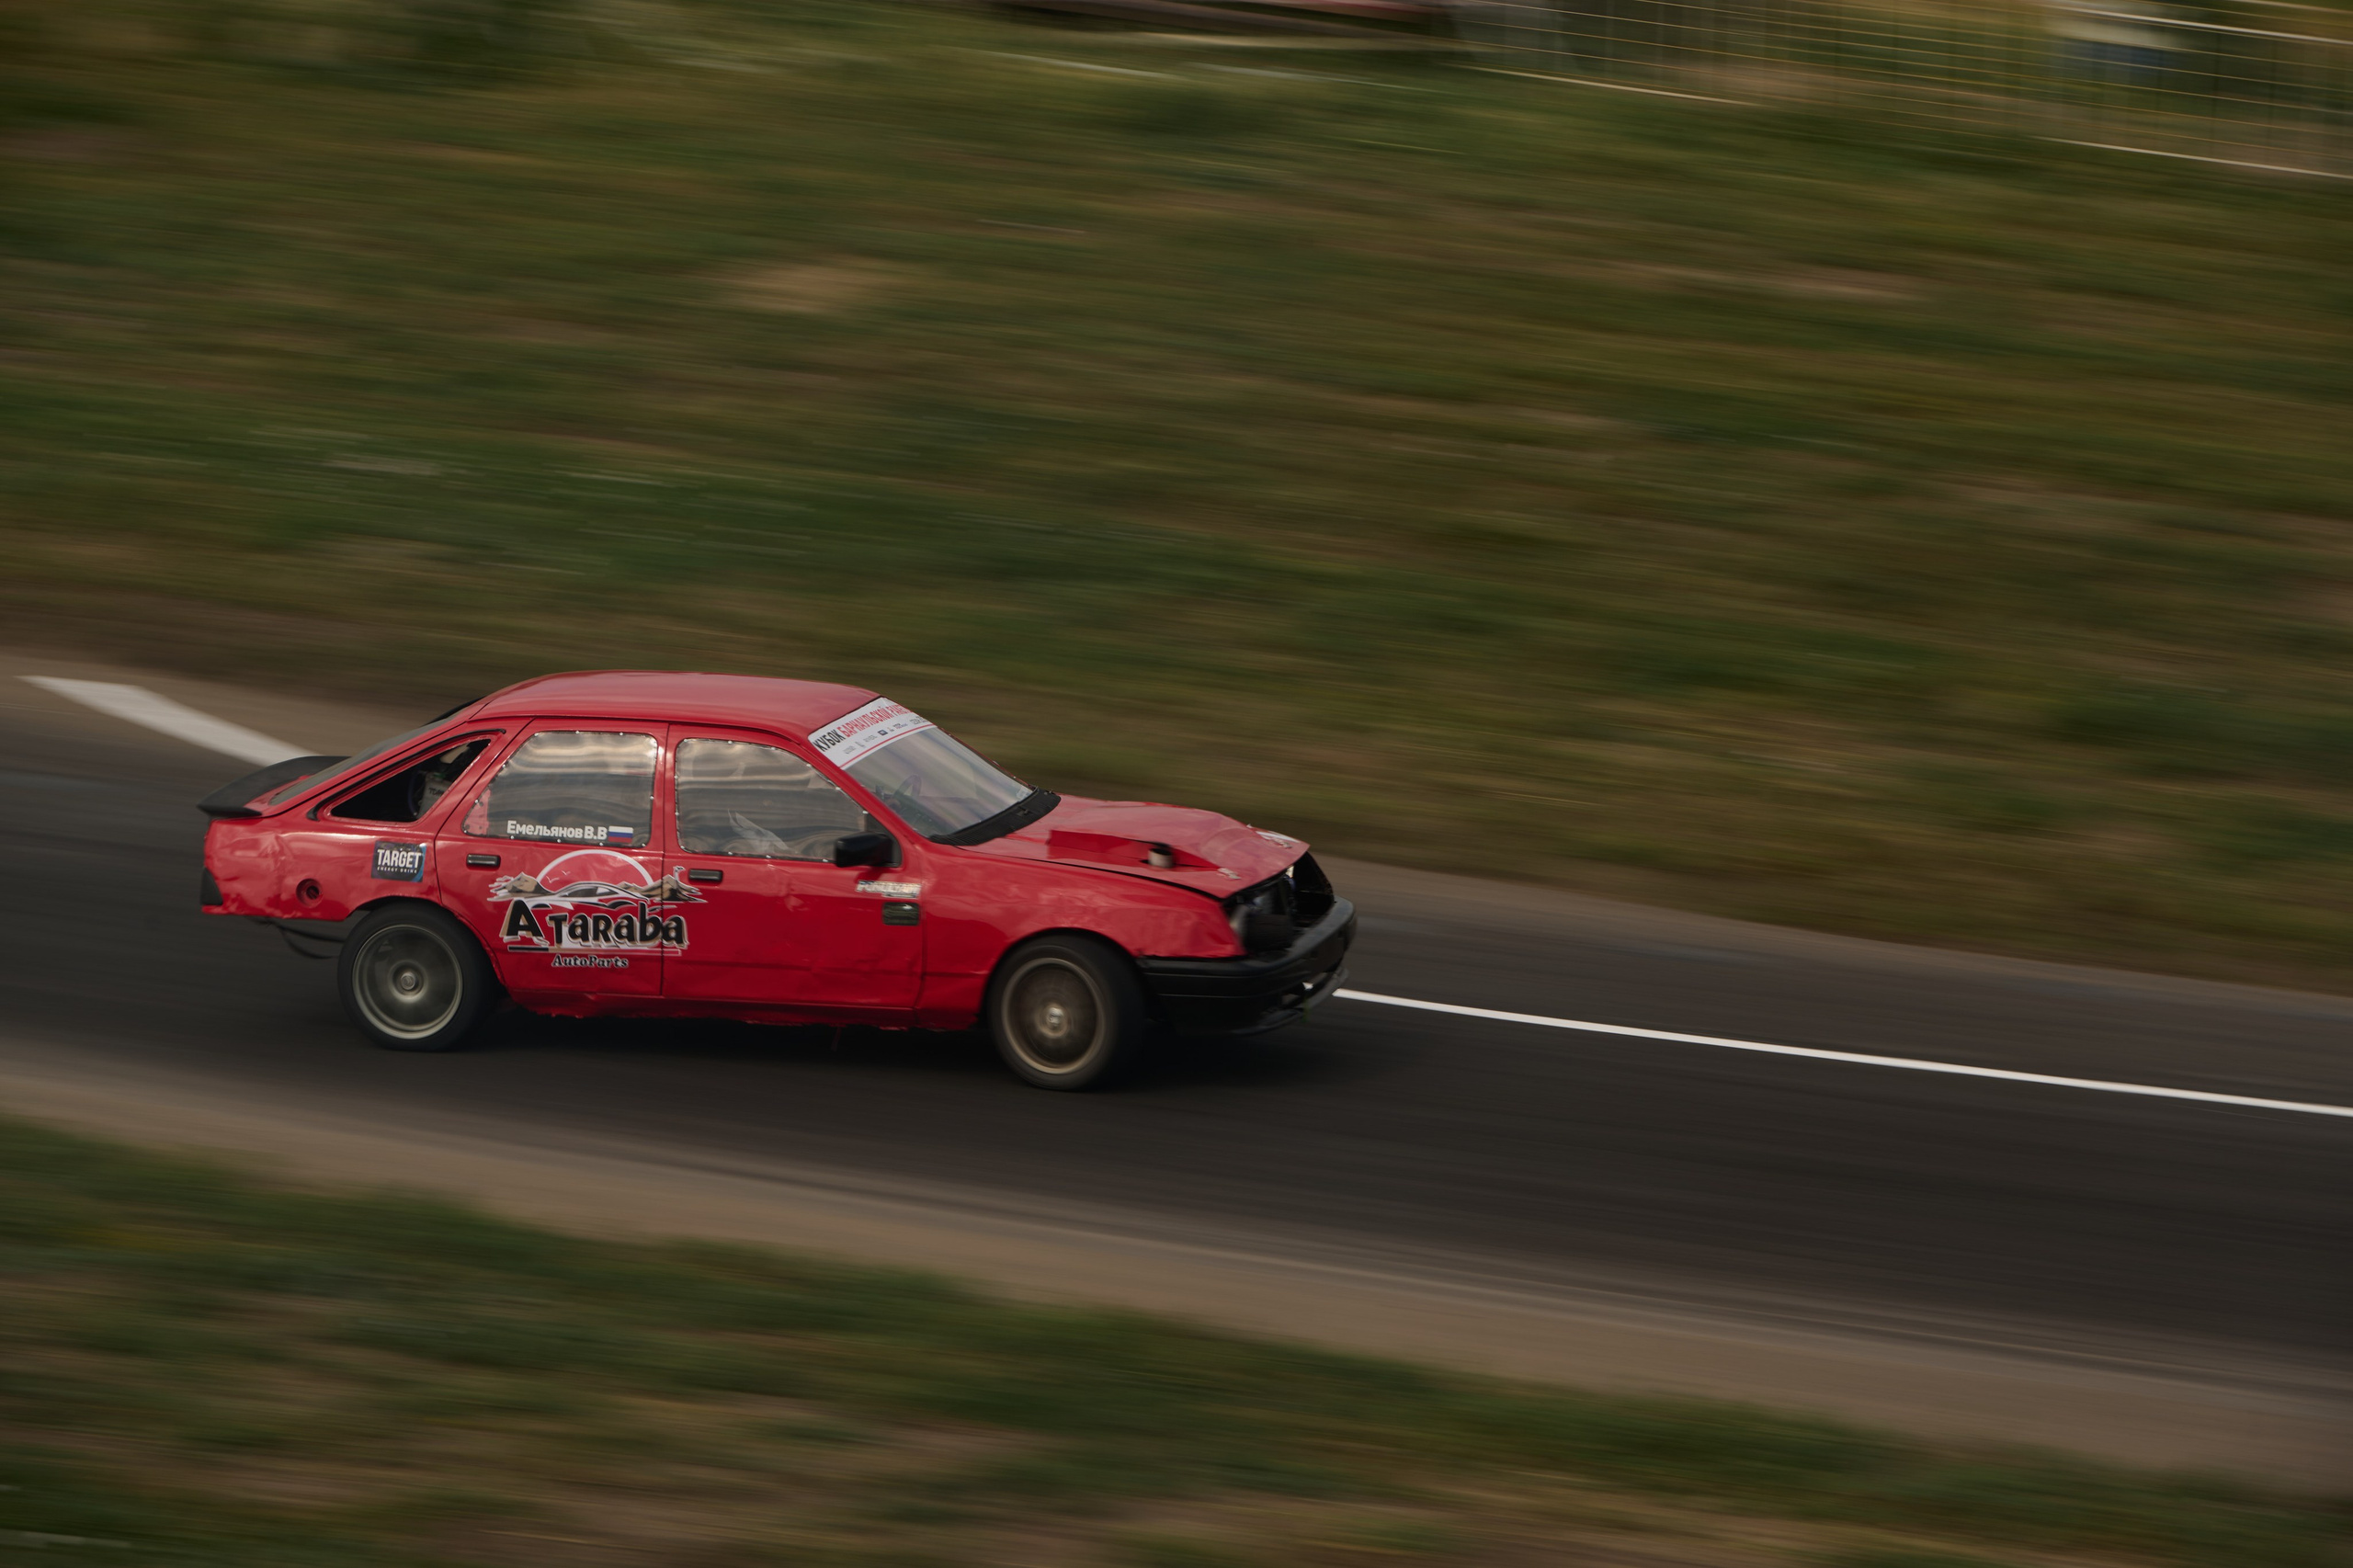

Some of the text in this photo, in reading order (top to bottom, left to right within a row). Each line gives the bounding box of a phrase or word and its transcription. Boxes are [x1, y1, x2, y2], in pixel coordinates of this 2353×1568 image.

[813, 729, 846, 752] КУБОК
[836, 706, 893, 737] БАРНАУЛЬСКОЙ
[506, 820, 607, 840] Емельянов В.В
[377, 849, 422, 869] TARGET
[551, 954, 629, 968] AutoParts
